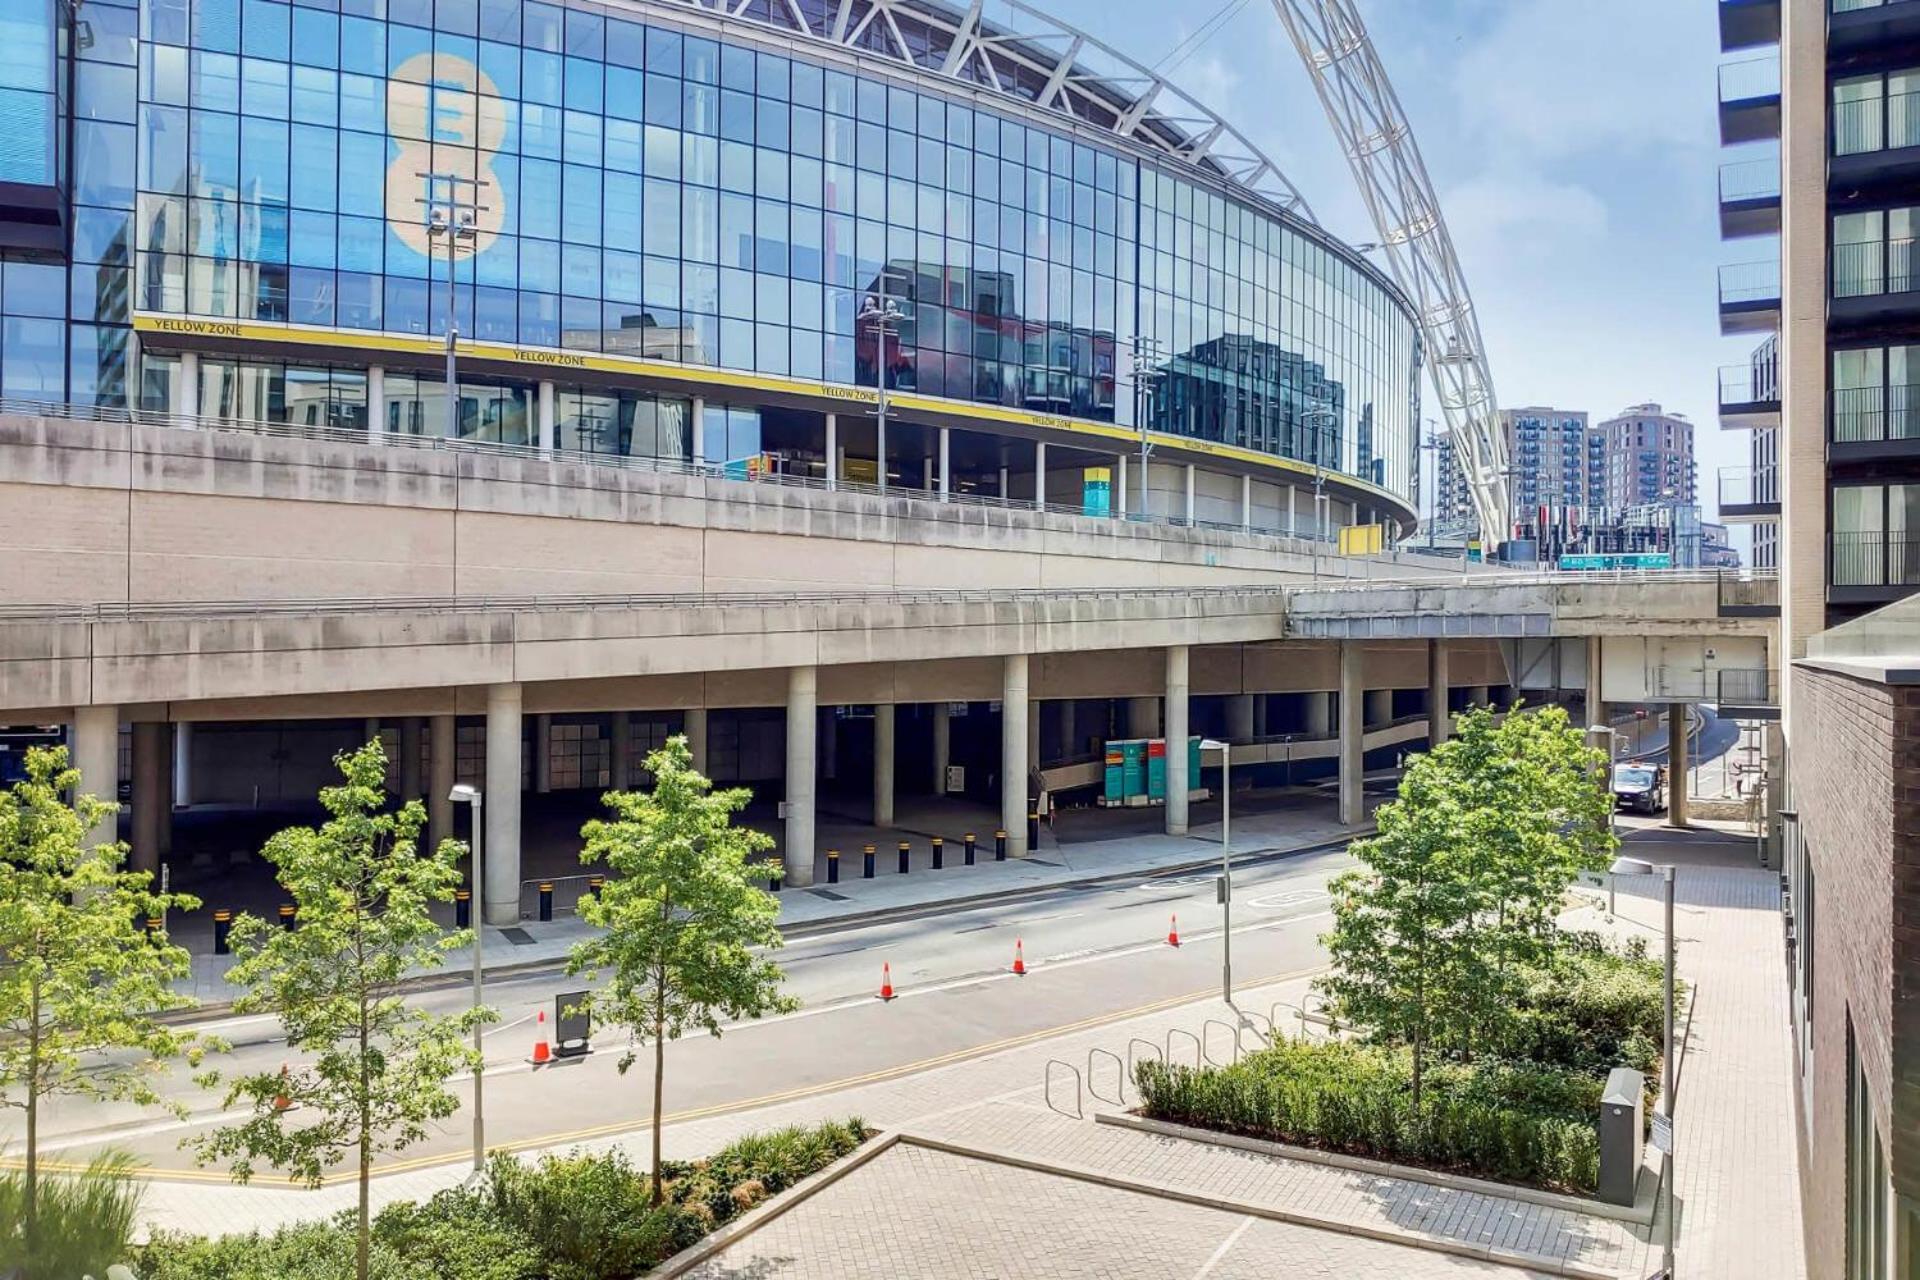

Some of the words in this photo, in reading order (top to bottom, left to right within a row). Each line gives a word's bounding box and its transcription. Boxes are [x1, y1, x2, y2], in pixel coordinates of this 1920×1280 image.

[155, 319, 205, 332] YELLOW
[207, 323, 242, 336] ZONE
[513, 349, 556, 363] YELLOW
[558, 354, 585, 366] ZONE
[821, 385, 854, 399] YELLOW
[855, 391, 877, 401] ZONE
